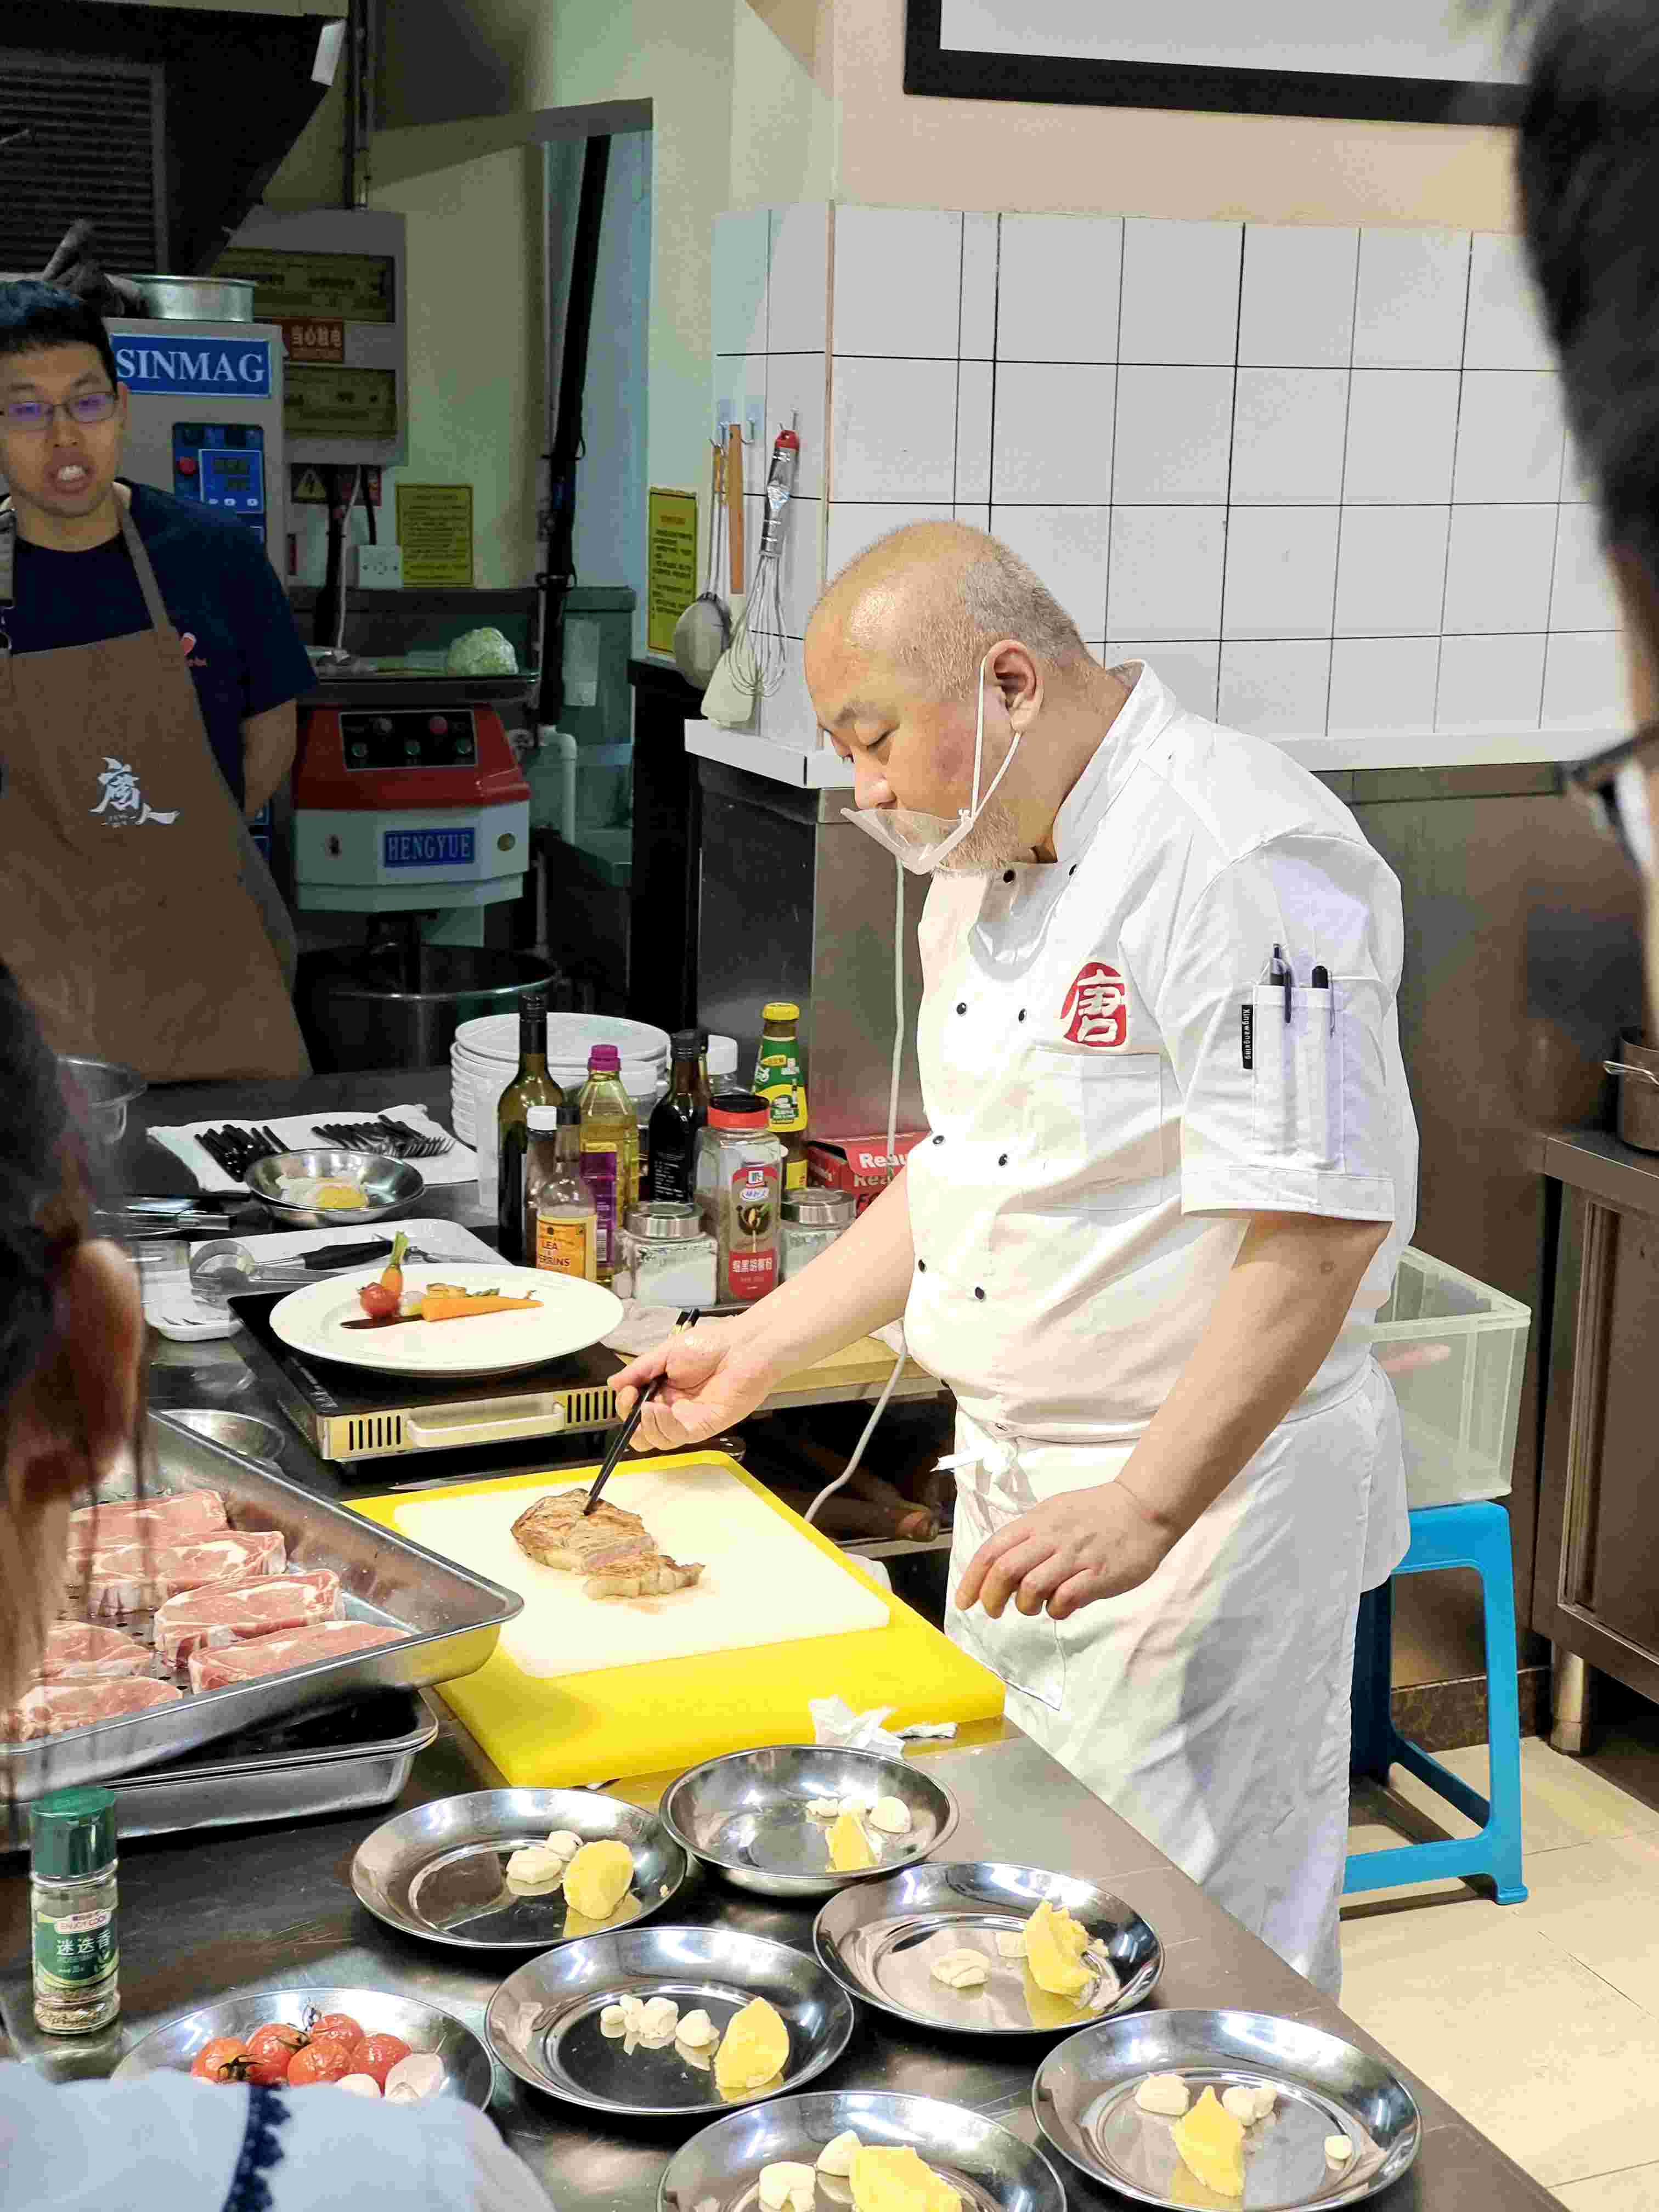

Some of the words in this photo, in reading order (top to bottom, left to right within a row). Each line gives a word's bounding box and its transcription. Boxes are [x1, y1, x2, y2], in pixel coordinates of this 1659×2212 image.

[116, 348, 266, 382] SINMAG
[388, 833, 471, 861] HENGYUE
[1242, 1008, 1252, 1060] Xingwangxing
[57, 1929, 111, 1956] 迷迭香
